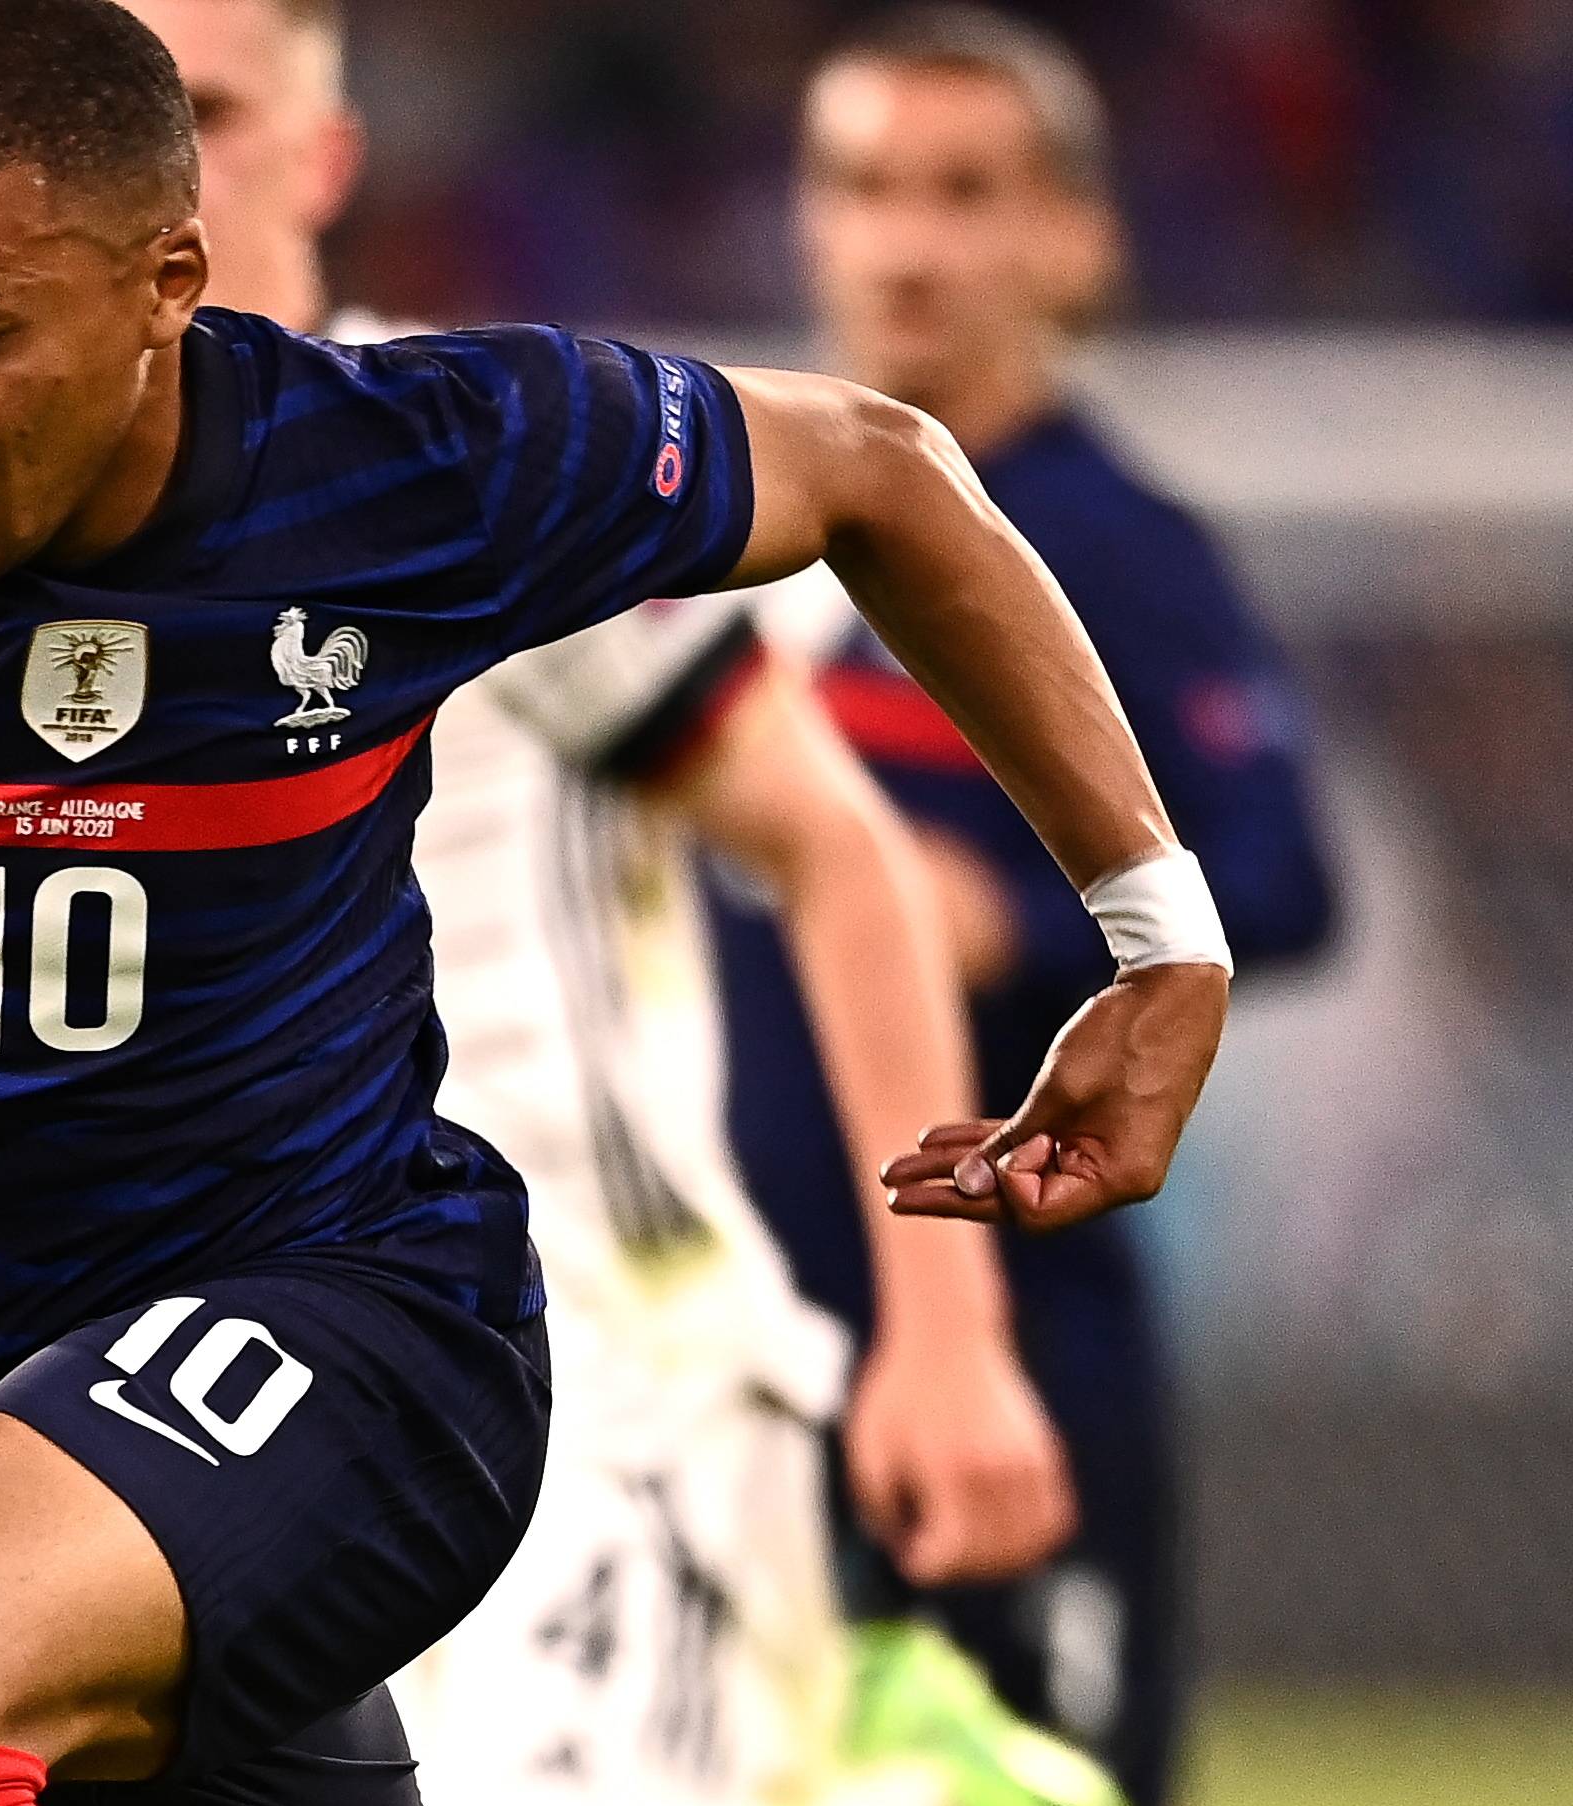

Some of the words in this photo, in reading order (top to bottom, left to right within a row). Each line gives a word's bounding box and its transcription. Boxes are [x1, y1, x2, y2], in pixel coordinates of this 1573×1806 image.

[55, 707, 107, 724] FIFA
[59, 799, 146, 820] ALLEMAGNE
[15, 816, 34, 835] 15
[72, 819, 115, 837] 2021
[103, 1296, 314, 1457] 10
